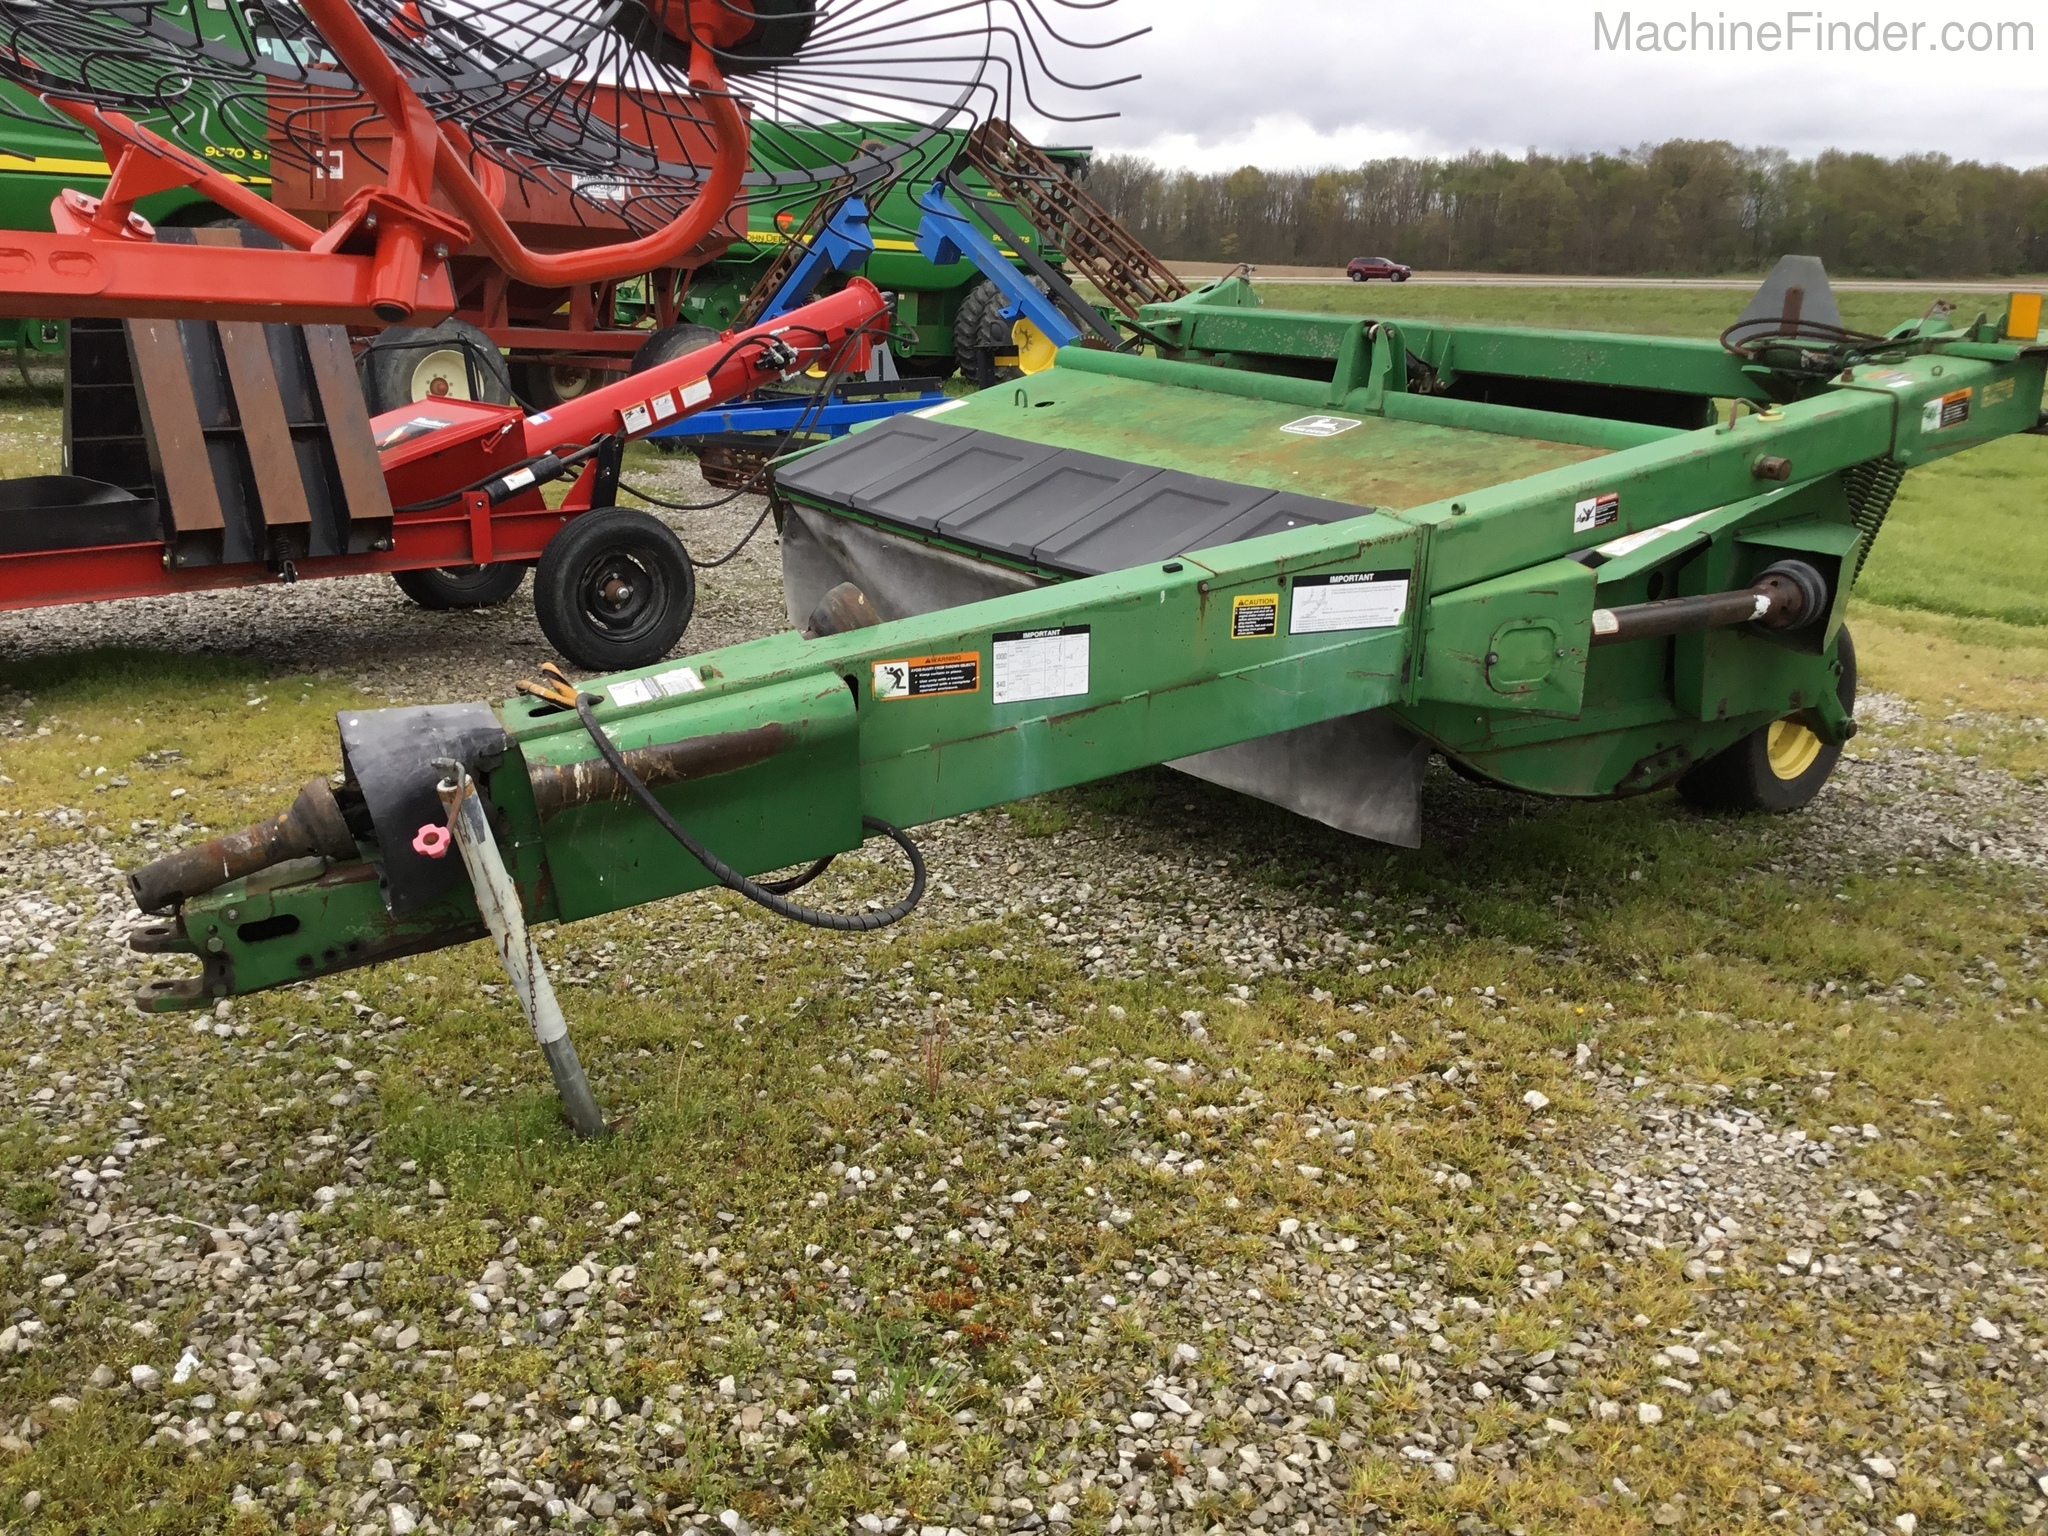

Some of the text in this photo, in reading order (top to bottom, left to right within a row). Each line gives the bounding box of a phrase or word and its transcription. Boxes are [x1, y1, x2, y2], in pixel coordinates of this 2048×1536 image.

[1329, 573, 1374, 584] IMPORTANT
[1244, 598, 1274, 606] CAUTION
[1022, 629, 1062, 639] IMPORTANT
[931, 655, 962, 663] WARNING
